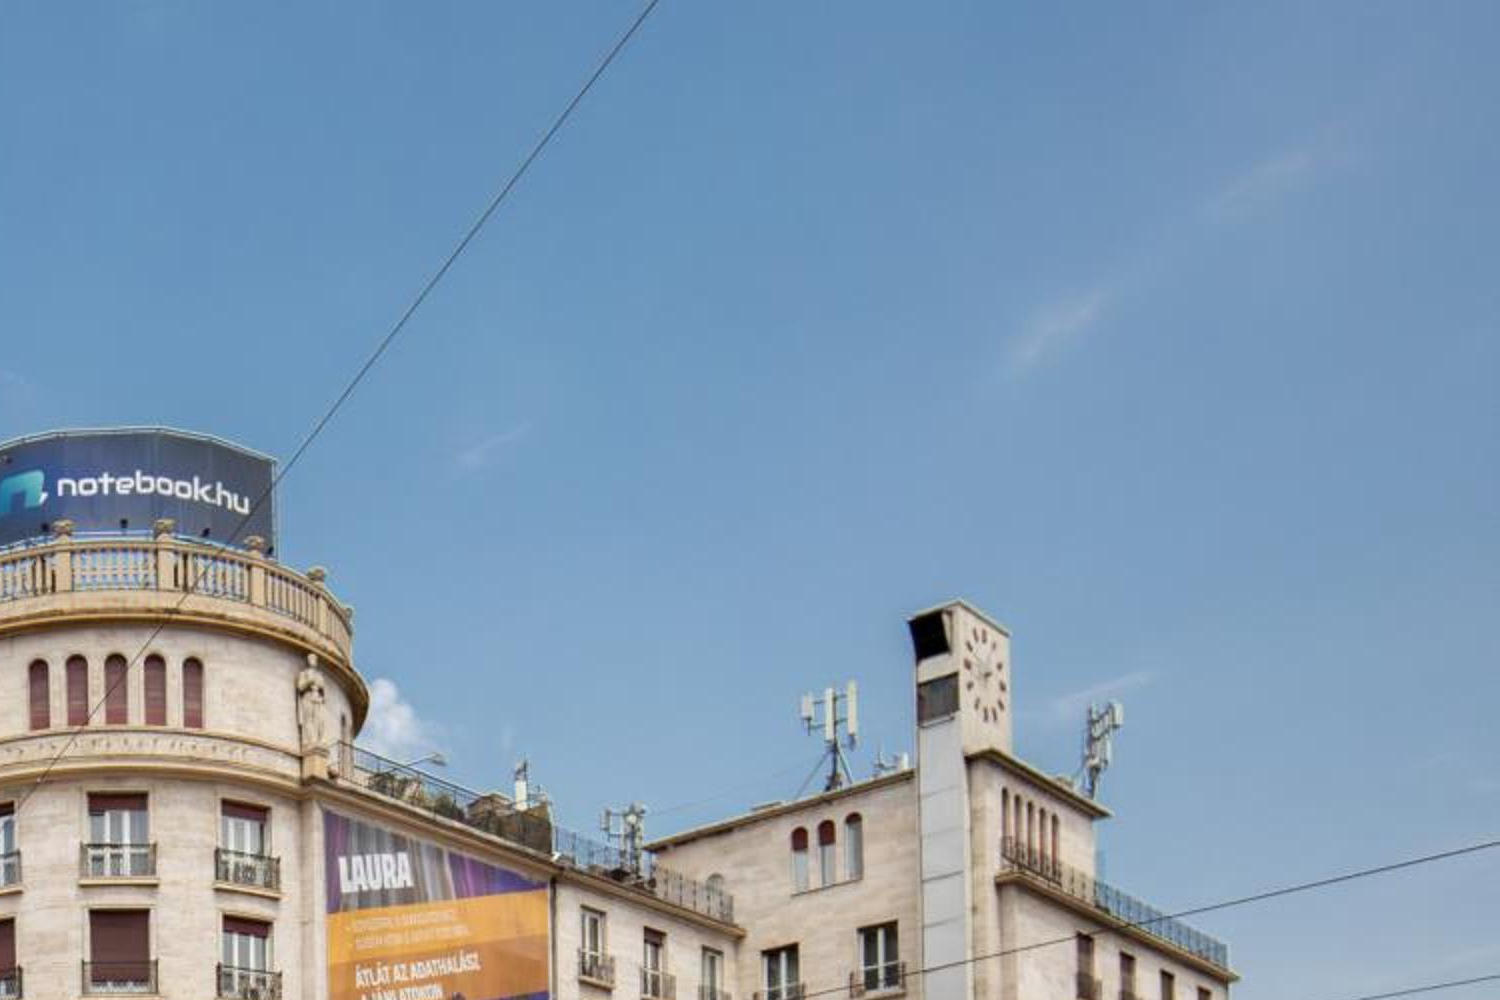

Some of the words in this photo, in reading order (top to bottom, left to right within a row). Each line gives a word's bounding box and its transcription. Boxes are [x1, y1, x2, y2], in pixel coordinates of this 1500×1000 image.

[57, 470, 249, 514] notebook.hu
[338, 852, 414, 893] LAURA
[393, 964, 409, 982] AZ
